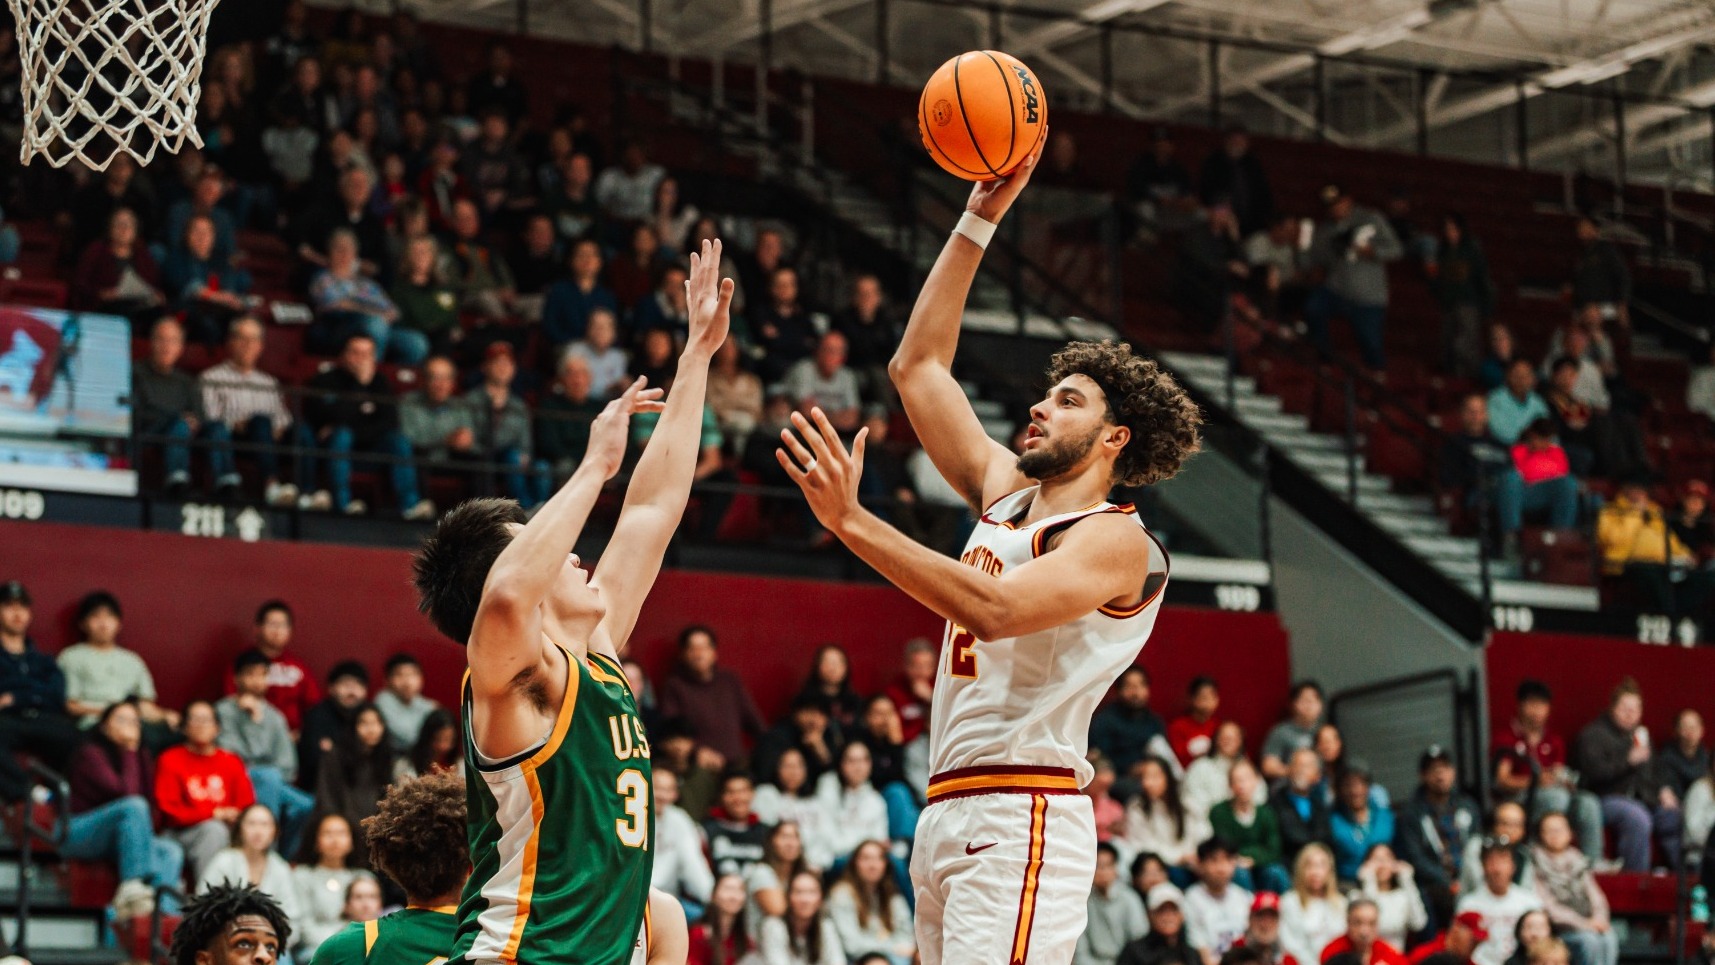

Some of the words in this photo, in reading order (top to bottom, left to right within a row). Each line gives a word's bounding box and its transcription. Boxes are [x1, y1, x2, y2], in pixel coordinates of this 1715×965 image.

[1013, 66, 1038, 123] NCAA
[182, 503, 225, 537] 211
[616, 768, 648, 851] 3
